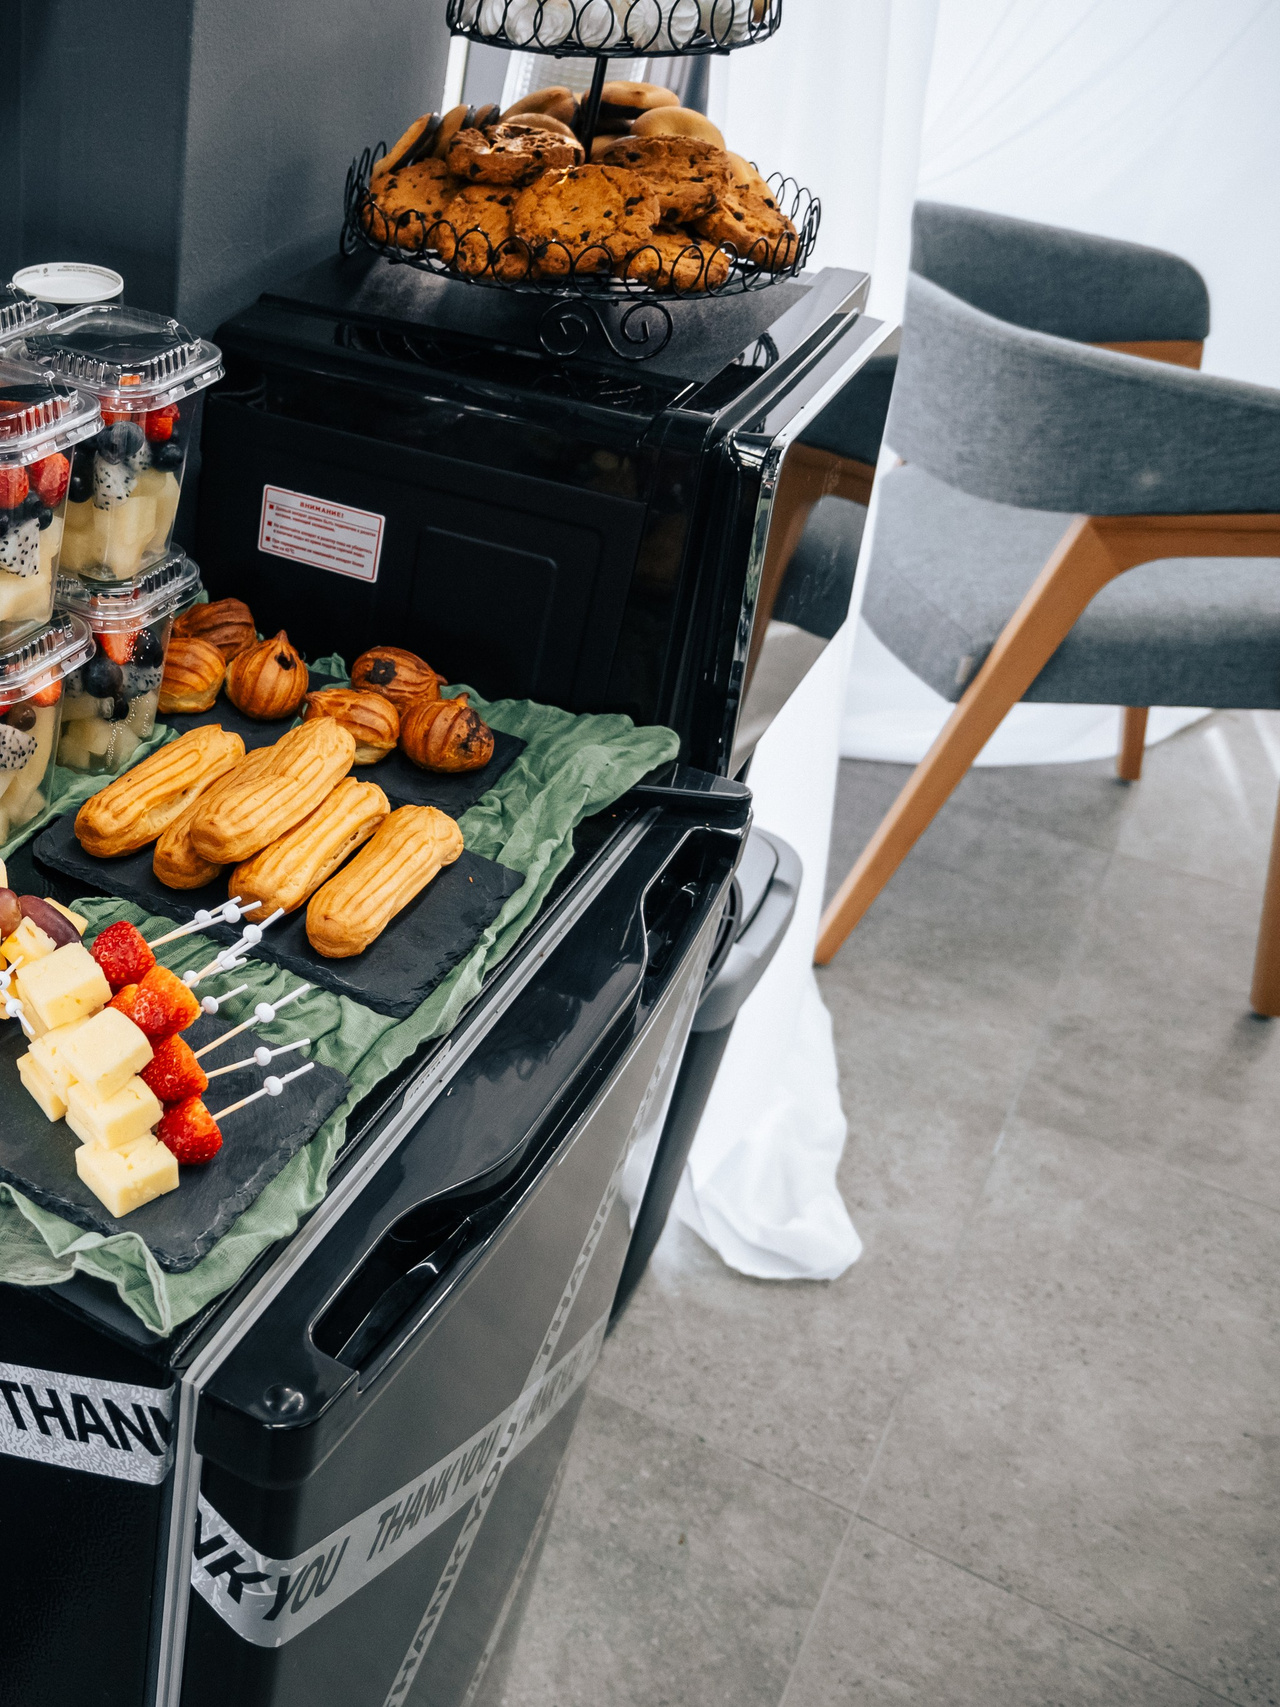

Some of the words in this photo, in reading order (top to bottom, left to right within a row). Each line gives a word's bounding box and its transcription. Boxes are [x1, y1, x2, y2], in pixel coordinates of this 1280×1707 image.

[300, 501, 344, 519] ВНИМАНИЕ!
[535, 1184, 617, 1366] THANK
[262, 1535, 351, 1621] YOU
[366, 1463, 455, 1562] THANK
[451, 1423, 502, 1497] YOU
[385, 1541, 468, 1707] HANK
[463, 1422, 518, 1535] YOU
